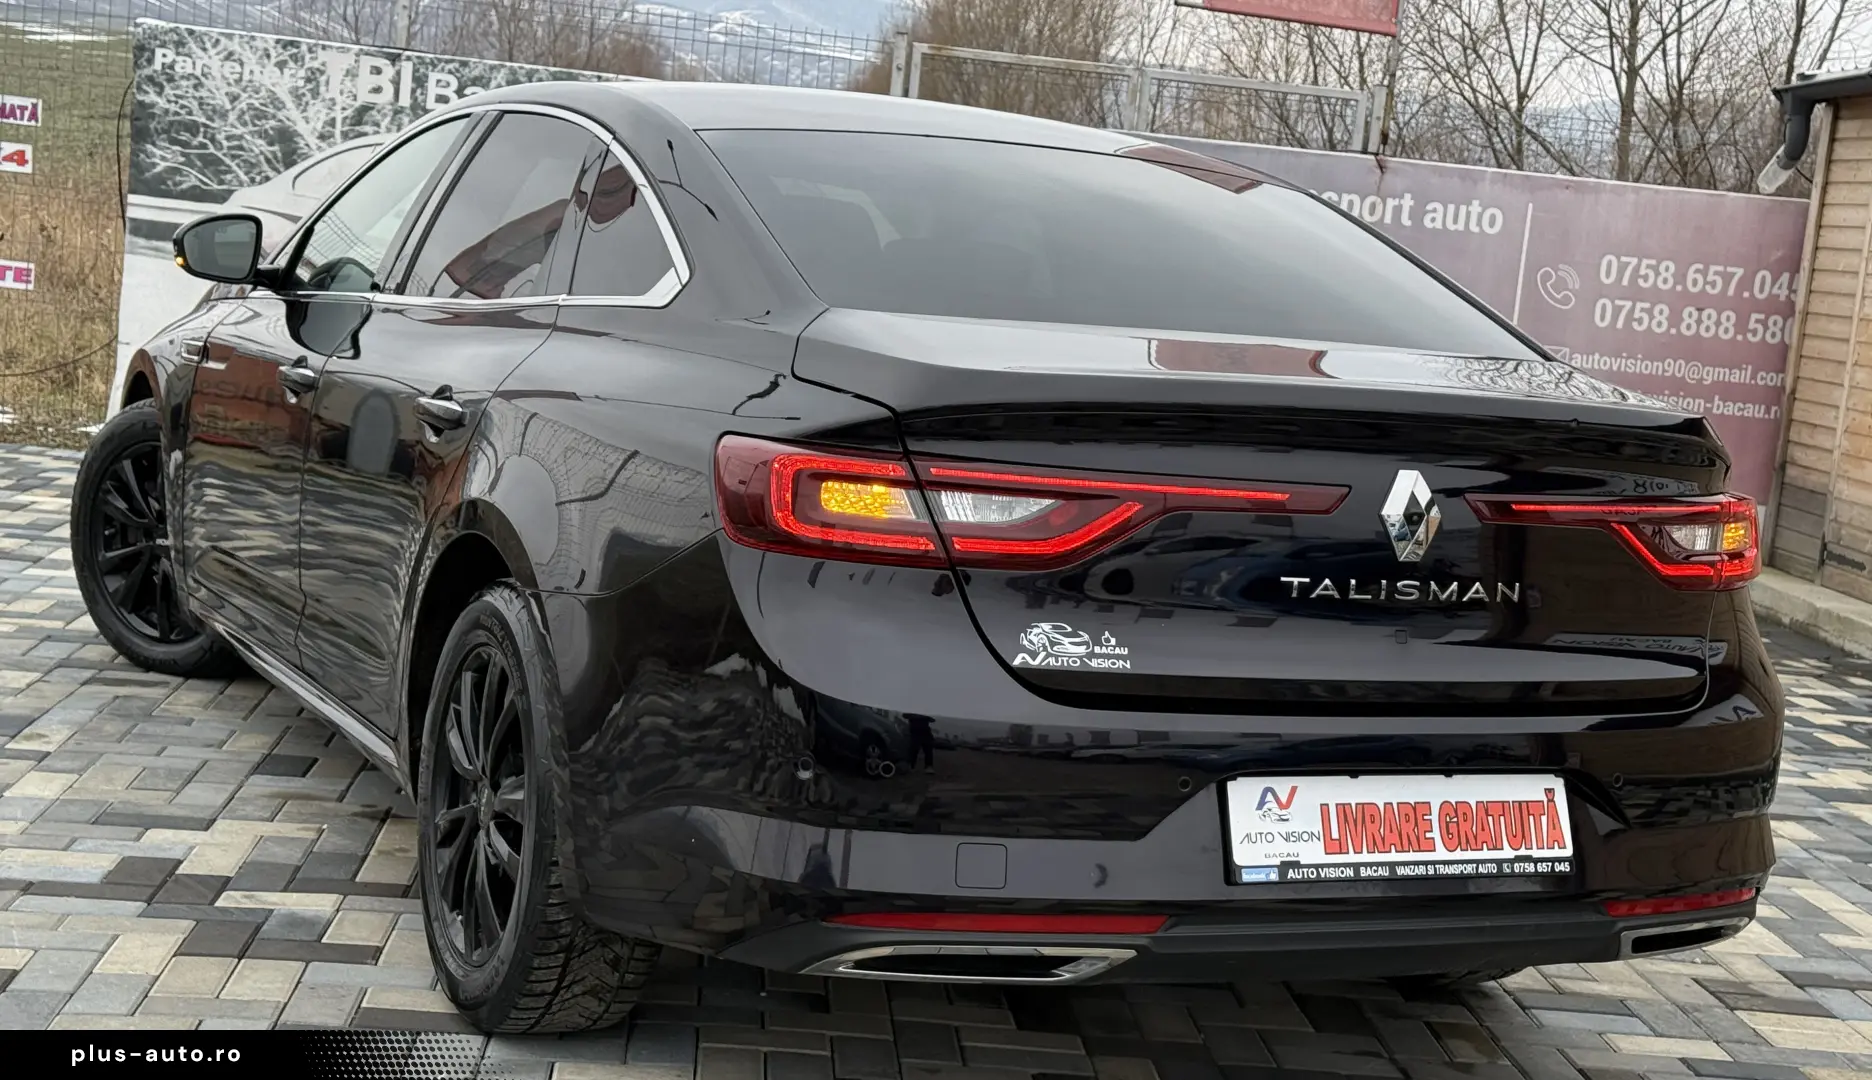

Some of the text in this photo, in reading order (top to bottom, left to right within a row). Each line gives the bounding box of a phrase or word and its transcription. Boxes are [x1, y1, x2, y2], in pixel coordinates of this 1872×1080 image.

[318, 50, 414, 107] TBI
[0, 147, 29, 167] 4
[1309, 188, 1504, 235] port auto
[1280, 576, 1520, 603] TALISMAN
[1094, 645, 1128, 655] BACAU
[1041, 656, 1081, 667] AUTO
[1083, 657, 1131, 669] VISION
[1319, 788, 1567, 856] LIVRARE GRATUITĂ
[1239, 830, 1321, 845] AUTO VISION
[1264, 851, 1300, 859] BACAU
[1287, 861, 1571, 879] AUTO VISION BACAU VANZARI SI TRANSPORT AUTO 0758 657 045
